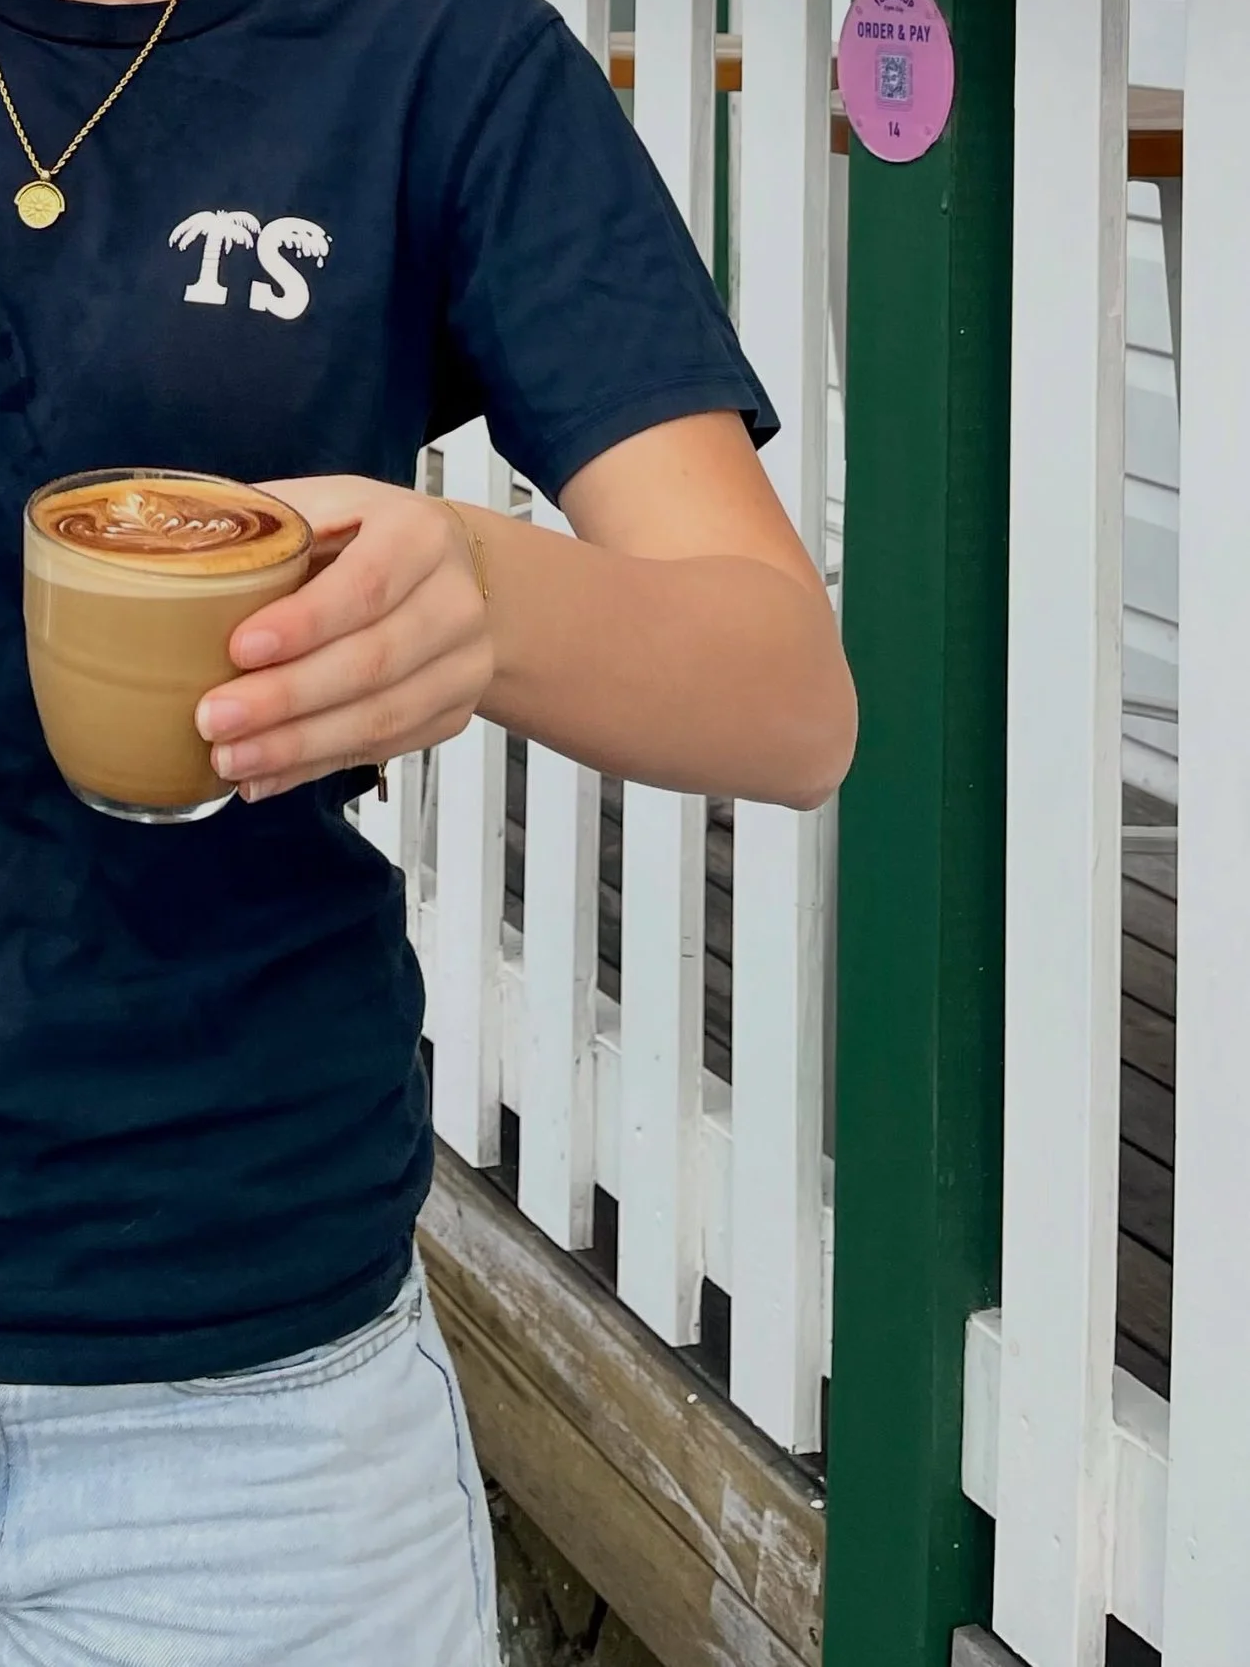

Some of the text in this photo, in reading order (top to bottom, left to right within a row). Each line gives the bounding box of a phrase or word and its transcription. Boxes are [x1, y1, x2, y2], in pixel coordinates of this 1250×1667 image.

[857, 21, 931, 43] ORDER & PAY
[888, 121, 901, 138] 14
[168, 209, 333, 320] TS
